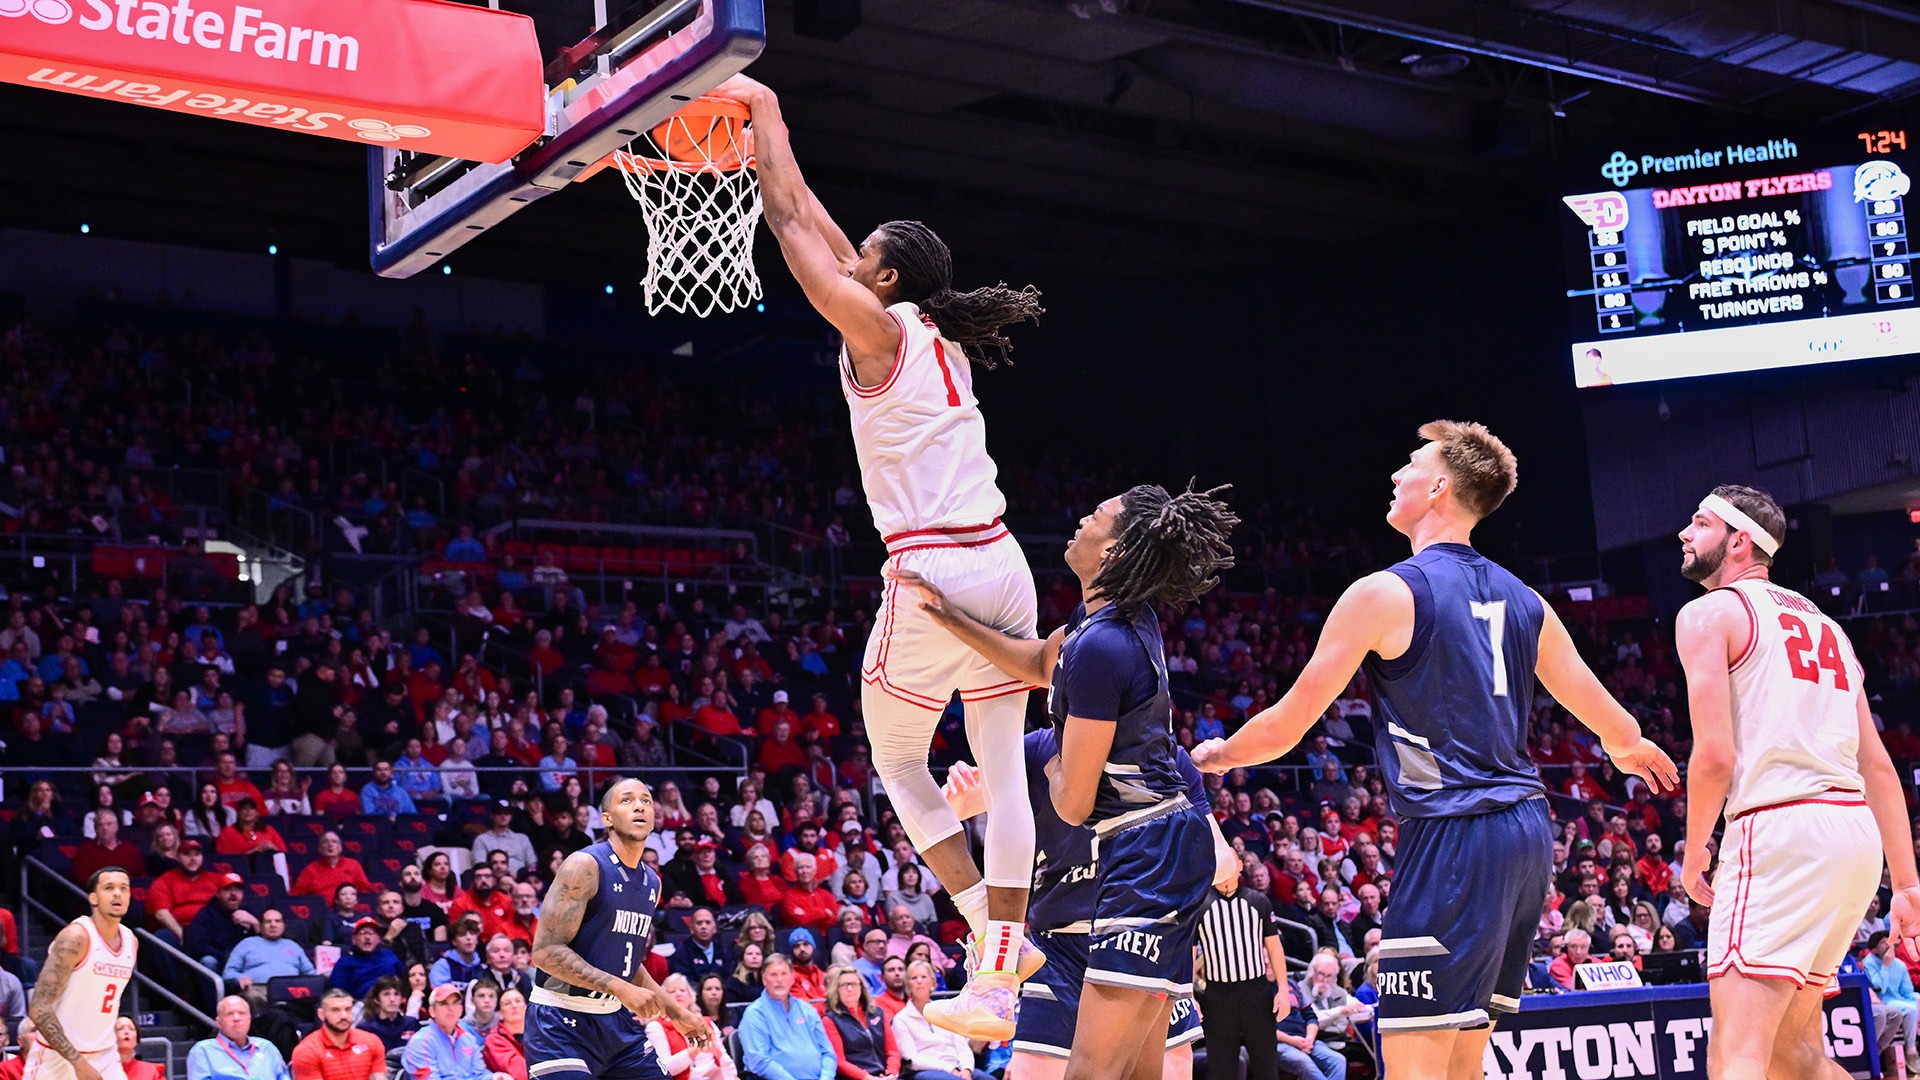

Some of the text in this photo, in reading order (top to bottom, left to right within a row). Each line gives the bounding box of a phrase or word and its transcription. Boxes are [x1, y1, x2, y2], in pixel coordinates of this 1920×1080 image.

[1641, 138, 1798, 174] Premier Health
[1858, 130, 1906, 154] 7:24
[1653, 171, 1833, 209] DAYTON FLYERS
[1687, 209, 1800, 237] FIELD GOAL %
[1702, 230, 1786, 254] 3 POINT %
[1884, 242, 1896, 256] 7
[1604, 252, 1617, 266] 0
[1700, 252, 1793, 277] REBOUNDS
[1602, 272, 1621, 288] 11
[1690, 271, 1828, 299] FREE THROWS %
[1699, 294, 1803, 319] TURNOVERS
[1611, 314, 1620, 328] 1
[934, 337, 961, 407] 1
[1468, 599, 1508, 697] 7
[1777, 612, 1850, 693] 24
[612, 909, 652, 938] NORTH
[622, 941, 633, 978] 3
[1582, 964, 1633, 982] WHIO
[101, 984, 117, 1013] 2
